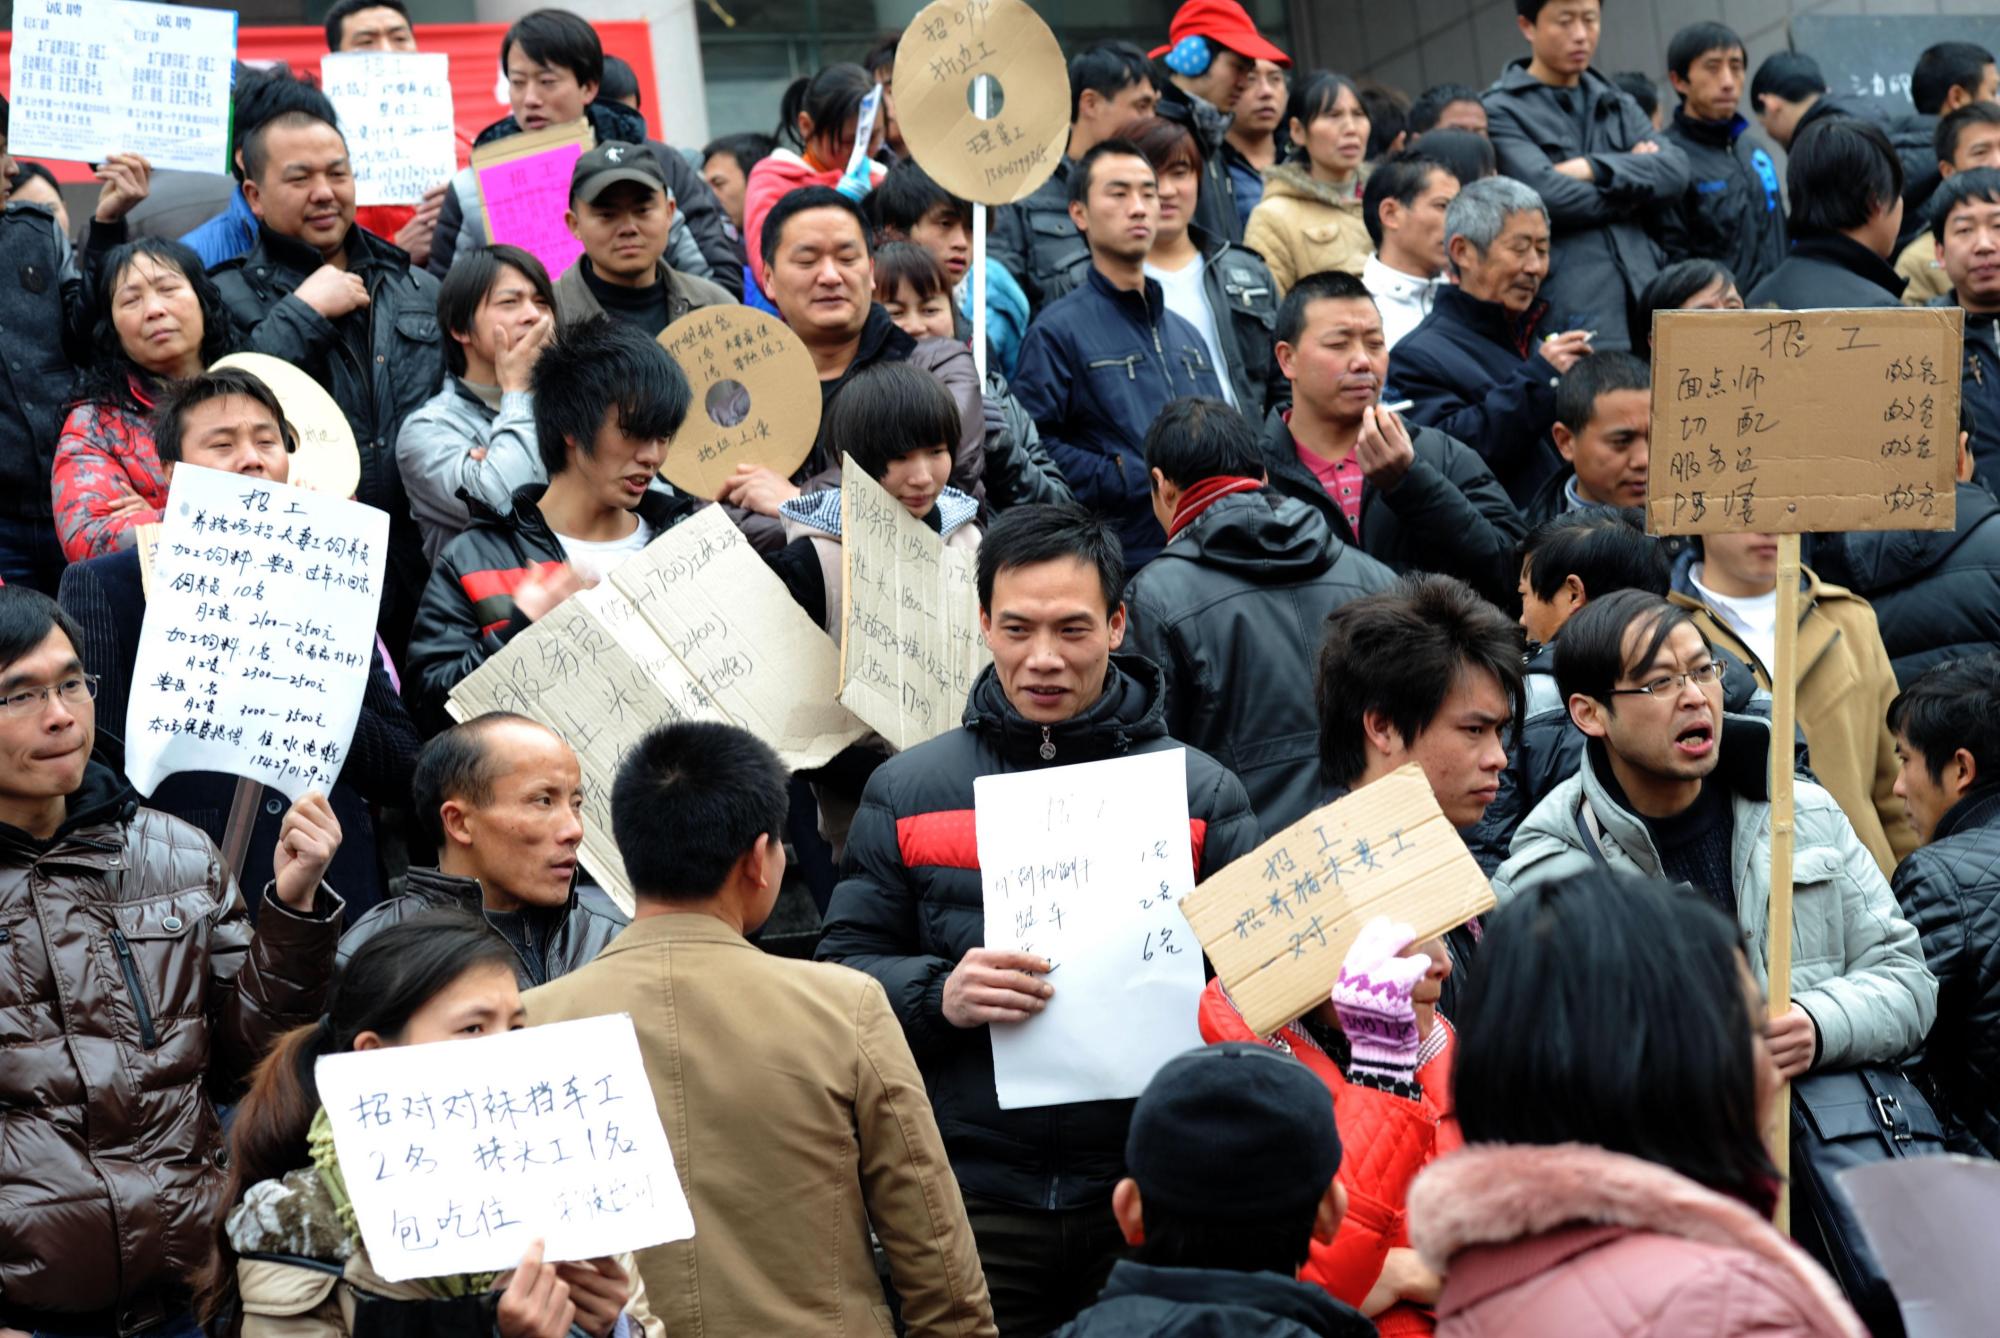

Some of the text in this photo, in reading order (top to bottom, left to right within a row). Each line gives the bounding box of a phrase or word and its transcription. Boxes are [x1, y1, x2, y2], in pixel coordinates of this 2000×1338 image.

[1753, 319, 1881, 359] 招工
[238, 488, 308, 515] 招工
[1262, 825, 1342, 881] 招工
[391, 1195, 522, 1252] 包吃住
